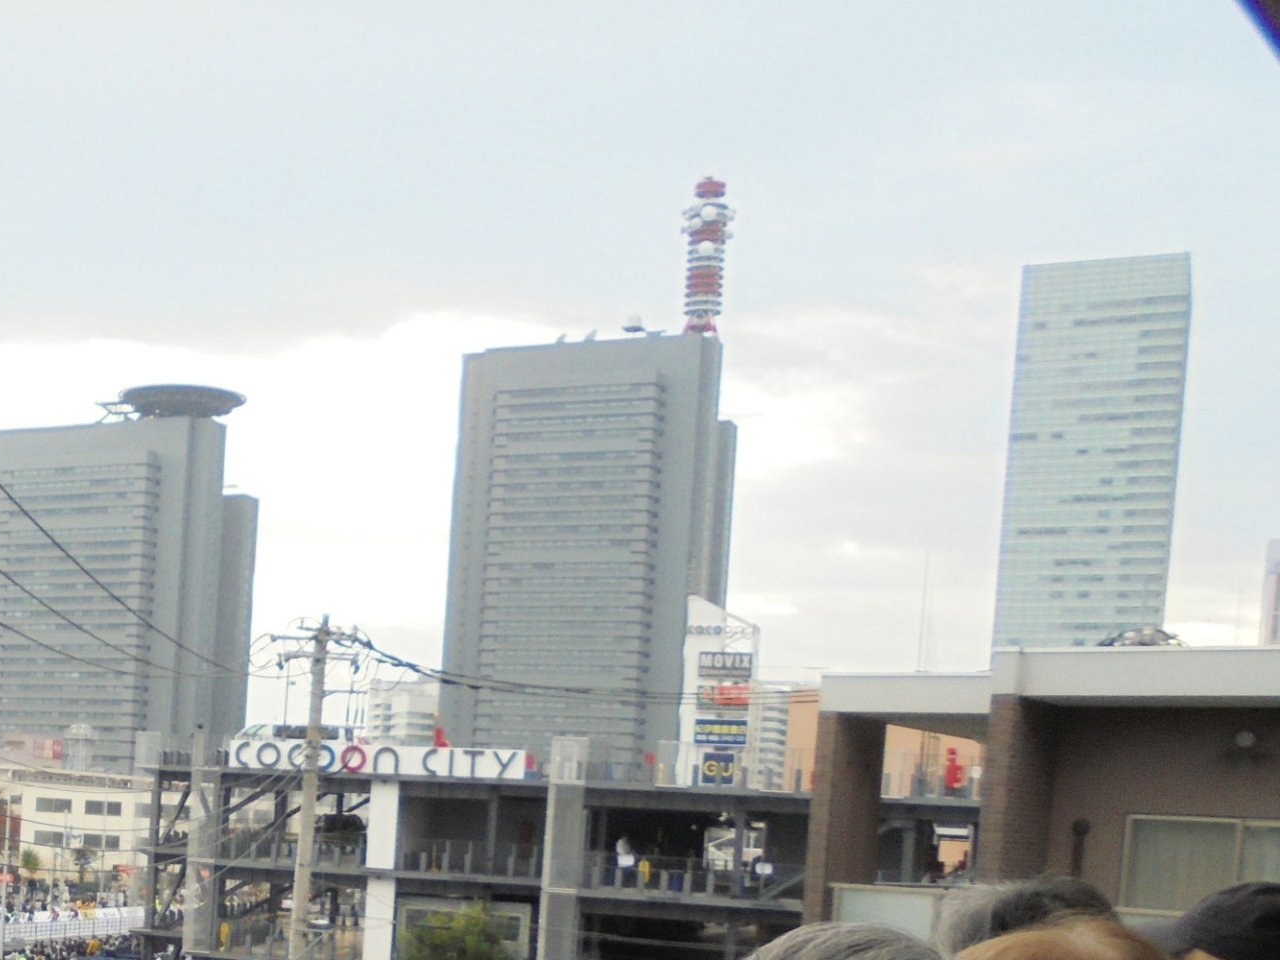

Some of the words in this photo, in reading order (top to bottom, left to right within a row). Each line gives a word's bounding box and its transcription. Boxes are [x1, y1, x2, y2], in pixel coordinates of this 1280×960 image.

[700, 653, 751, 668] MOVIX
[235, 741, 400, 775] COCOON
[422, 748, 518, 778] CITY
[702, 760, 733, 777] GU
